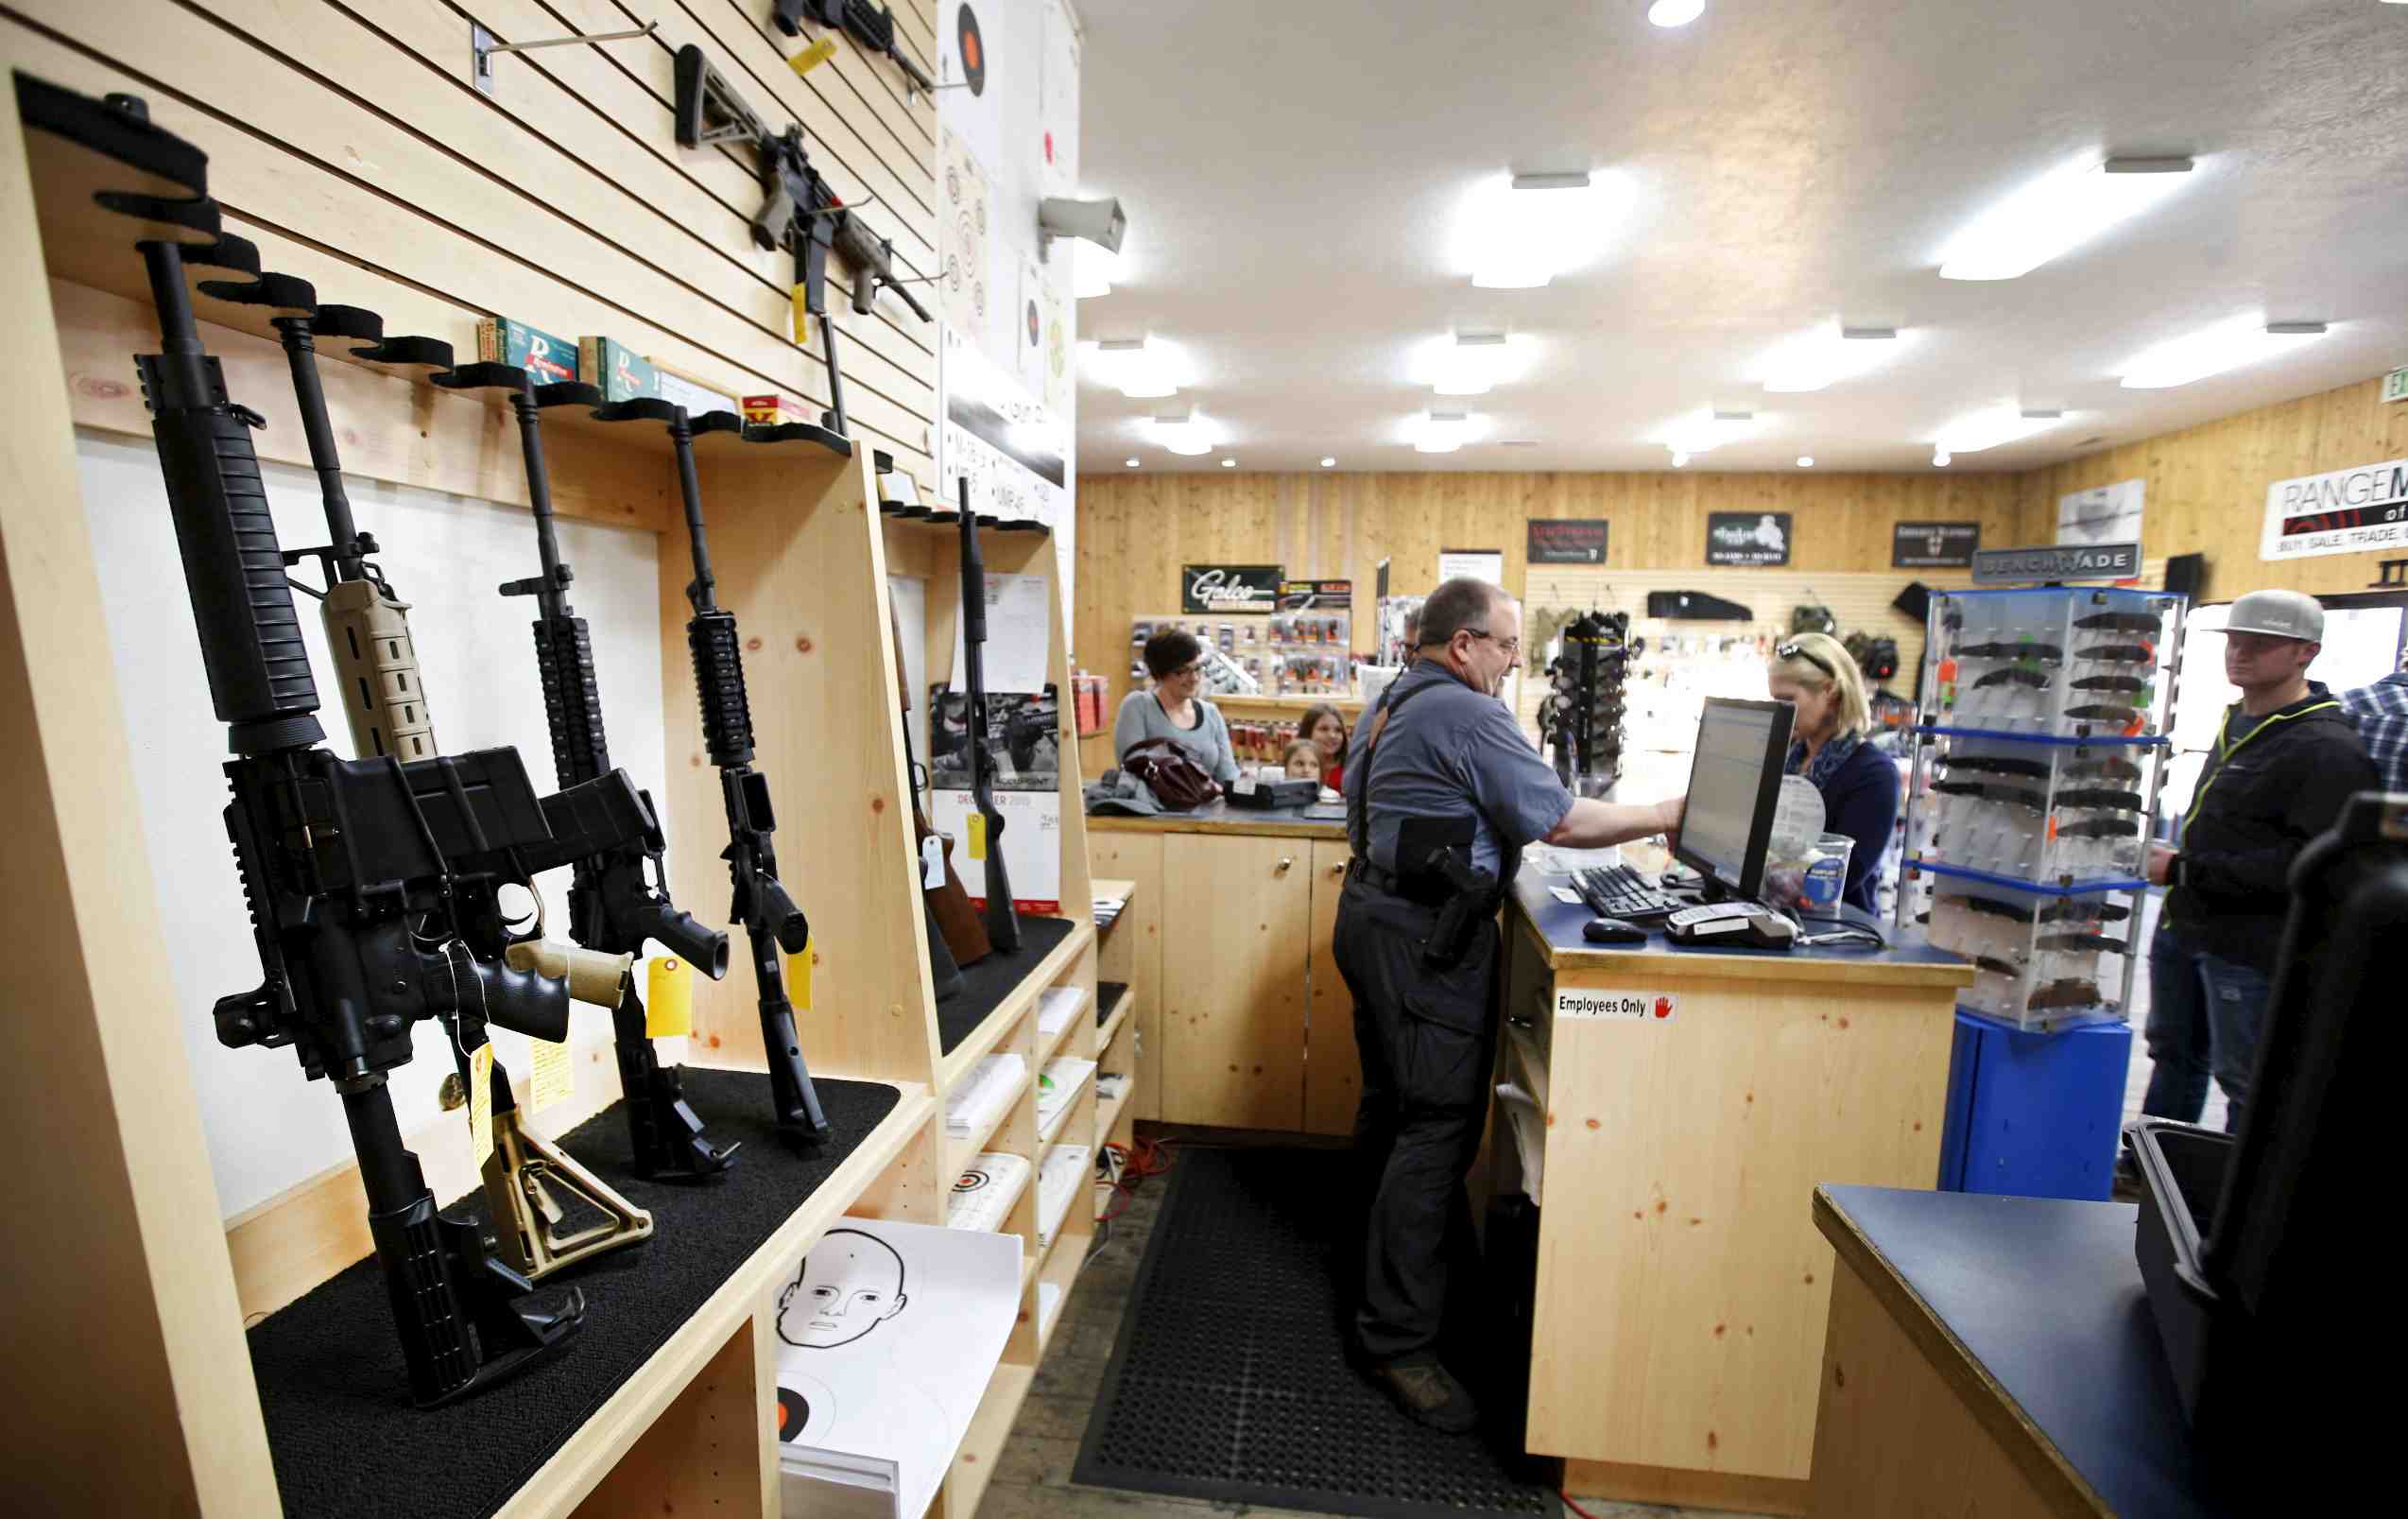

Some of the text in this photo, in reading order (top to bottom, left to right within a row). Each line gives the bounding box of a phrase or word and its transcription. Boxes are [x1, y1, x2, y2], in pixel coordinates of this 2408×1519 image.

[2349, 527, 2398, 544] TRADE
[1559, 995, 1645, 1017] Employees Only
